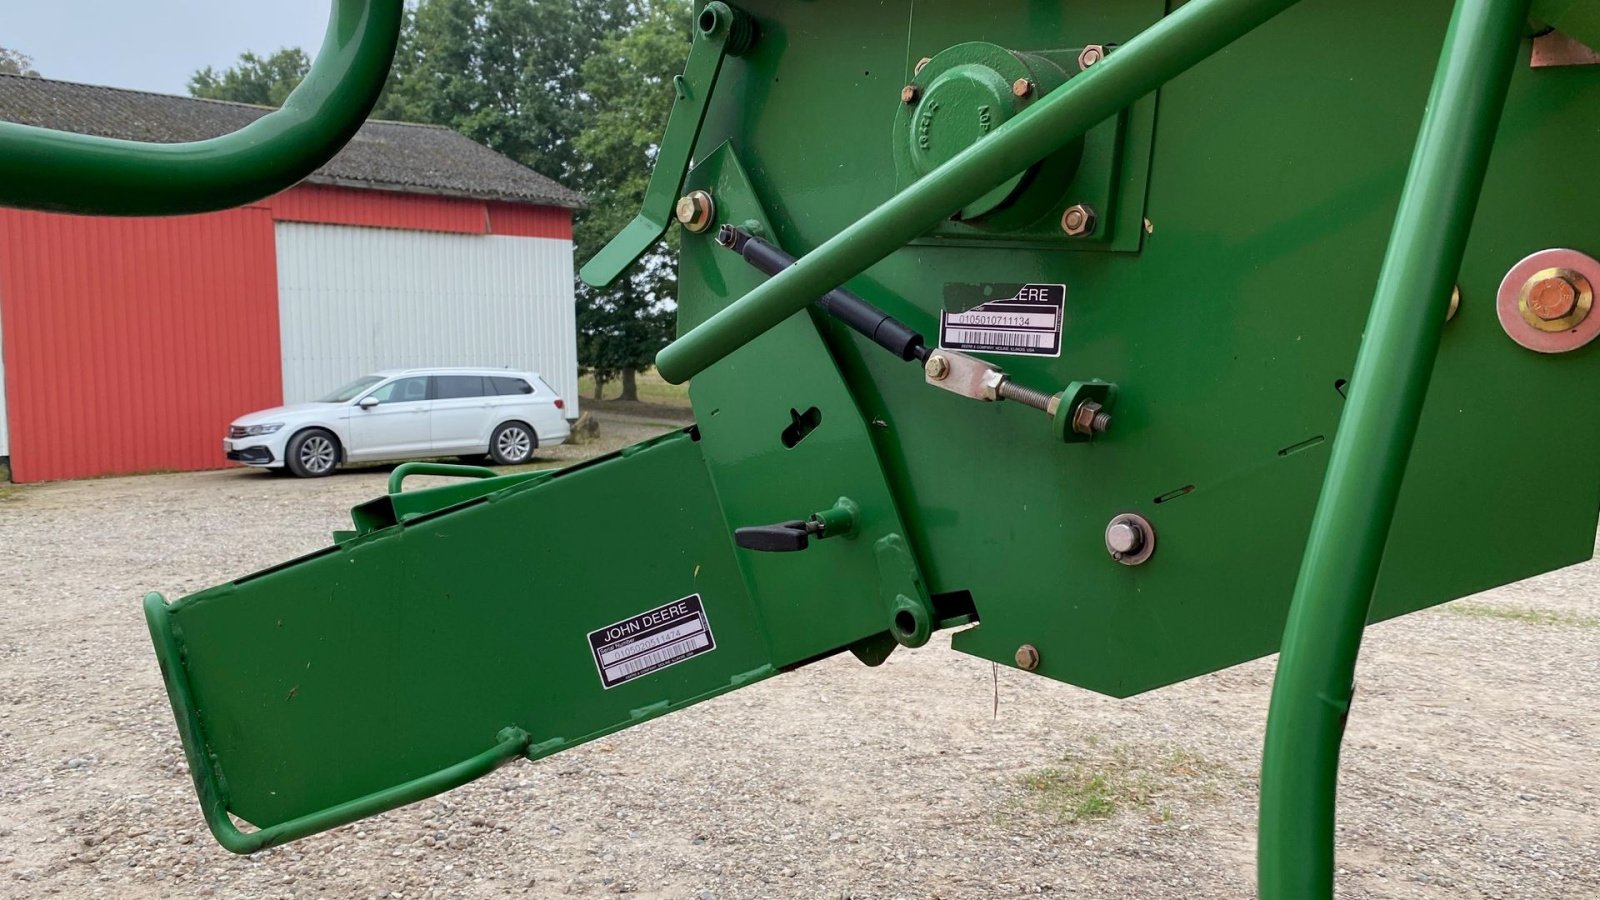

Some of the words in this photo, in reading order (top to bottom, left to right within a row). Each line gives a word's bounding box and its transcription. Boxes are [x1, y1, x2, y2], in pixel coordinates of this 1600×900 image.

[1014, 288, 1049, 302] ERE
[959, 315, 1030, 327] 0105010711134
[604, 620, 640, 642] JOHN
[642, 602, 689, 628] DEERE
[614, 630, 681, 660] 0105020511474
[615, 638, 635, 649] Number
